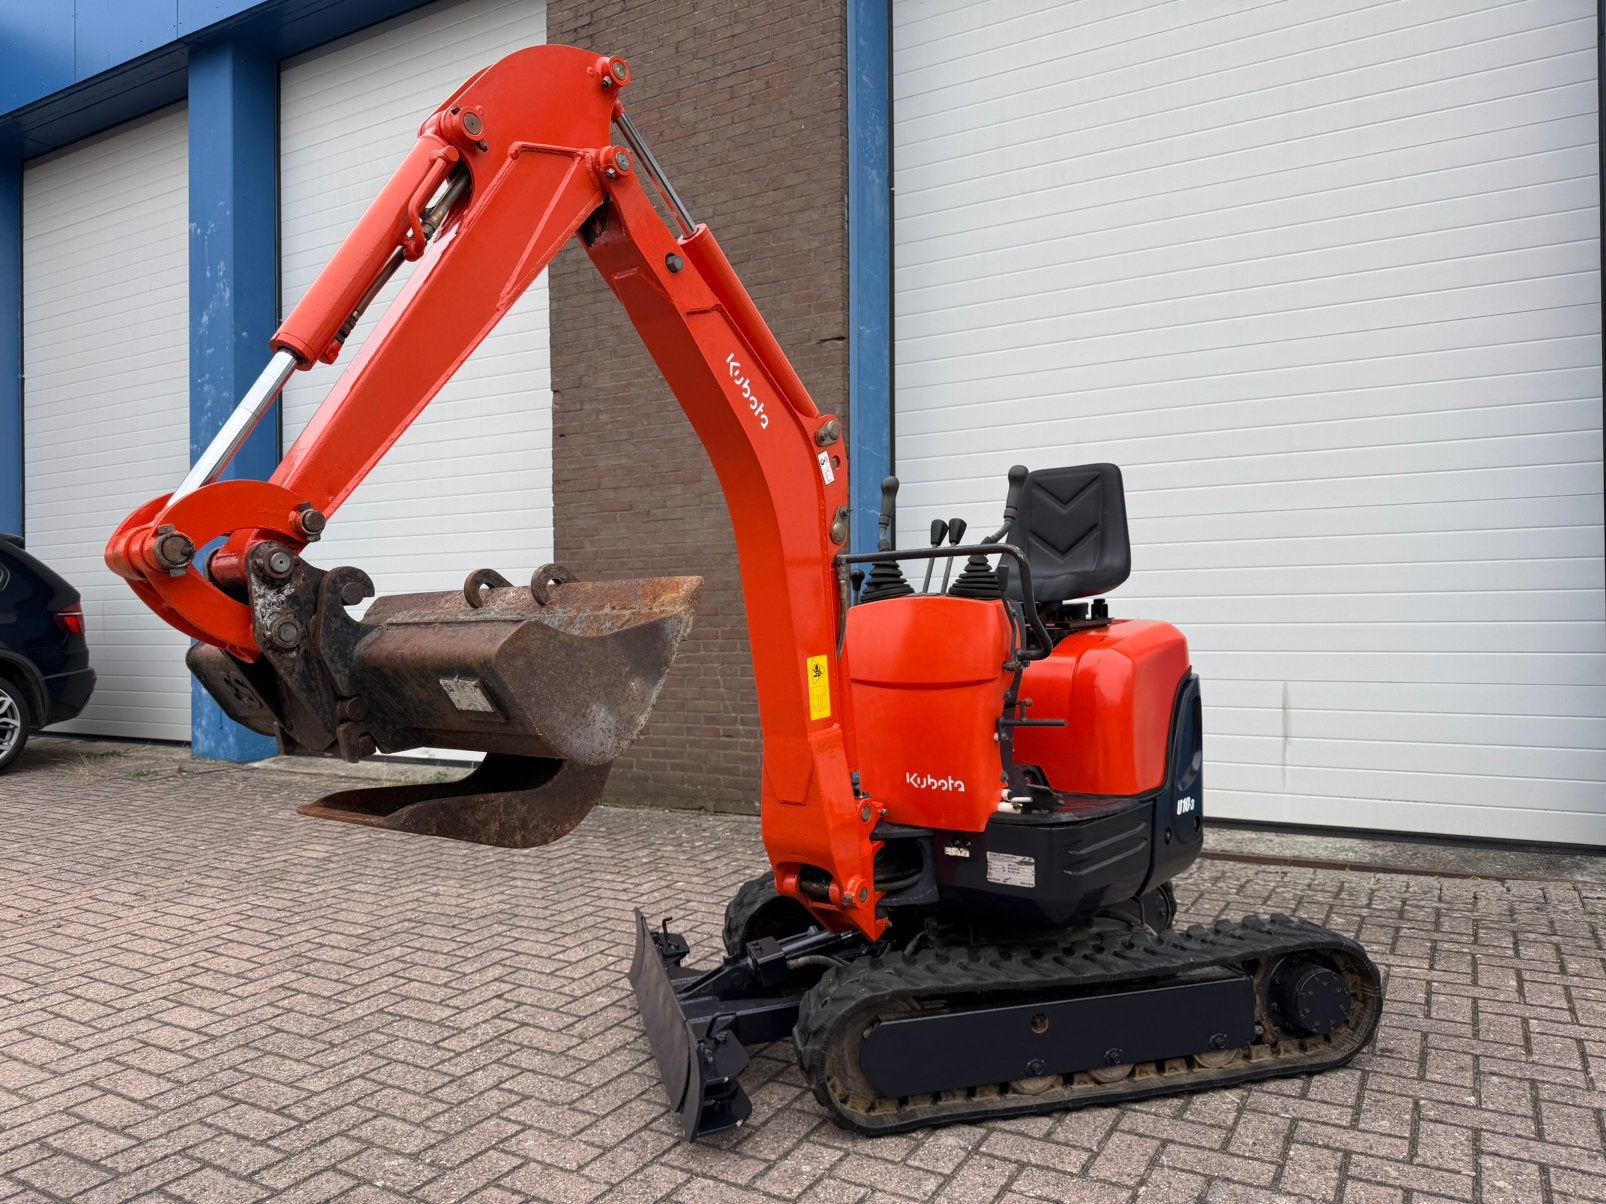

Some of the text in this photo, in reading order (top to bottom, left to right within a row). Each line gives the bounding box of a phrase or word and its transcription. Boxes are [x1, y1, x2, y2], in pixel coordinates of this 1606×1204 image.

[726, 352, 769, 430] Kubota
[905, 771, 966, 792] Kubota
[1176, 796, 1195, 816] U10-3
